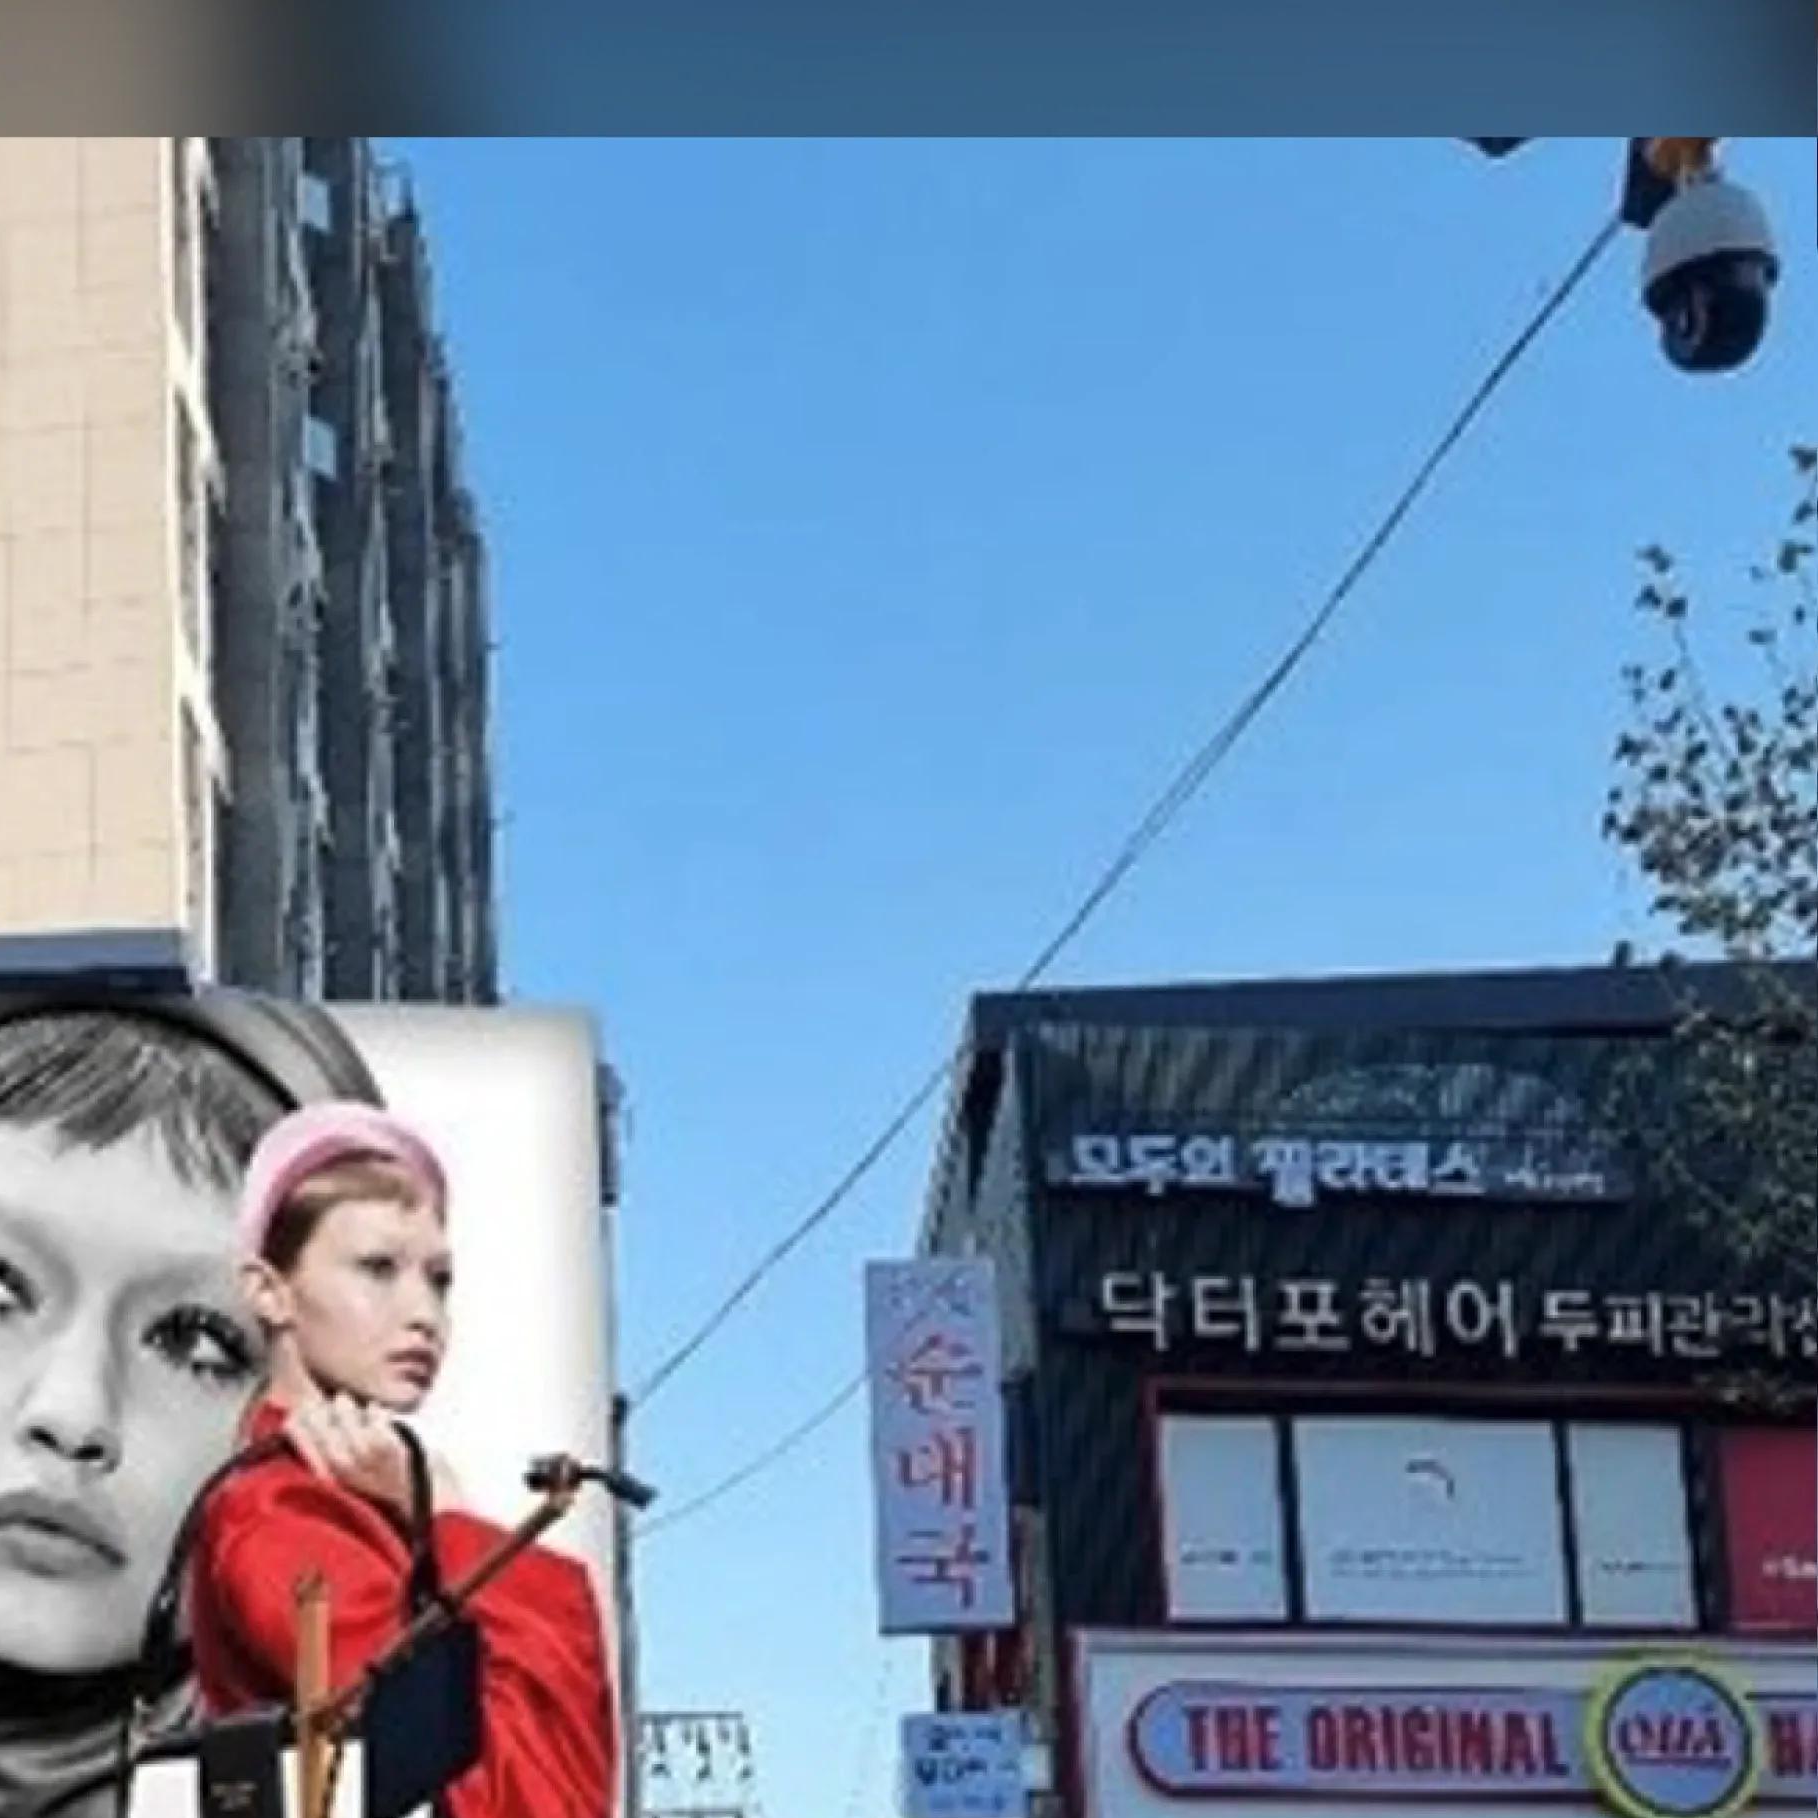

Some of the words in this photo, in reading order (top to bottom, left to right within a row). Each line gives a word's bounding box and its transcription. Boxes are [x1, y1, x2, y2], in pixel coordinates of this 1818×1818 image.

[1102, 1271, 1516, 1357] 닥터포헤어
[1184, 1706, 1283, 1772] THE
[1304, 1703, 1569, 1776] ORIGINAL
